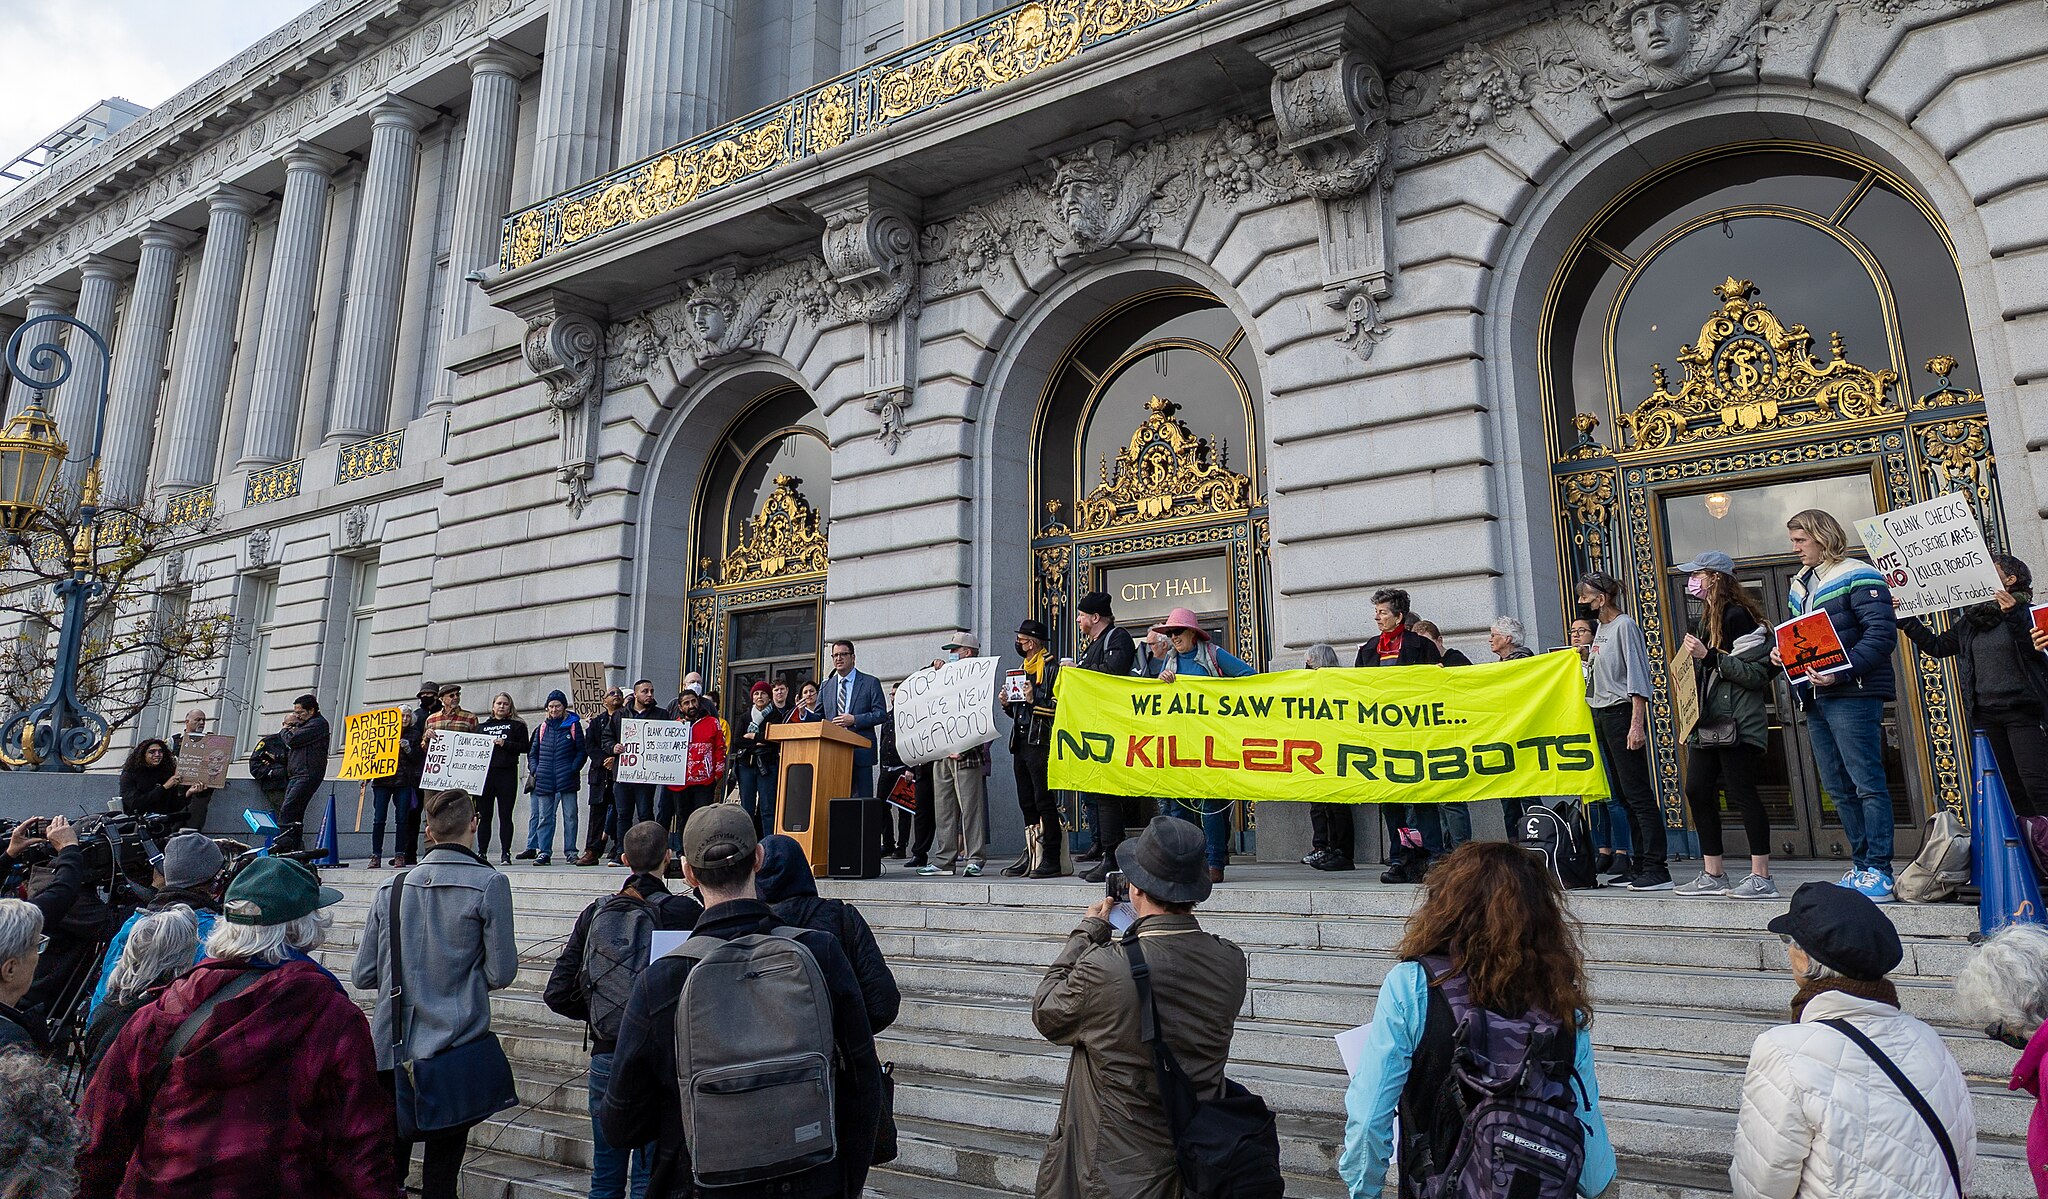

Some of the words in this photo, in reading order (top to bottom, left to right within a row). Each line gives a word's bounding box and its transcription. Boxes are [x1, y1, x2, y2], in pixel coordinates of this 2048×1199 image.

[1891, 514, 1924, 537] BLANK
[1925, 502, 1967, 527] CHECKS
[1904, 544, 1923, 559] 375
[1921, 531, 1949, 556] SECRET
[1869, 551, 1901, 571] VOTE
[1915, 562, 1947, 580] KILLER
[1945, 551, 1983, 574] ROBOTS
[1882, 568, 1909, 589] NO
[1121, 582, 1160, 602] CITY
[1165, 576, 1212, 597] HALL
[1812, 653, 1844, 669] ROBOTS!
[571, 663, 602, 680] KILL
[576, 679, 600, 690] THE
[897, 670, 937, 705] STOP
[572, 689, 606, 702] KILLER
[958, 683, 991, 712] NEW
[1131, 693, 1162, 716] WE
[1167, 692, 1209, 716] ALL
[1217, 693, 1274, 718] SAW
[1281, 696, 1349, 720] THAT
[1357, 701, 1468, 728] MOVIE...
[350, 710, 398, 732] ARMED
[351, 722, 399, 746] ROBOTS
[647, 727, 663, 737] BLANK
[664, 727, 687, 738] CHECKS
[350, 737, 397, 760] AREN'T
[458, 736, 472, 746] BLANK
[472, 737, 491, 748] CHECKS
[646, 740, 655, 750] 375
[656, 741, 671, 750] SECRET
[361, 753, 377, 761] THE
[428, 754, 448, 764] VOTE
[454, 748, 464, 757] 375
[620, 754, 638, 767] NO
[645, 753, 659, 763] KILLER
[660, 754, 682, 764] ROBOTS
[1056, 728, 1115, 763] NO
[1125, 734, 1325, 775] KILLER
[1336, 733, 1595, 784] ROBOTS
[343, 758, 396, 777] ANSWER
[424, 763, 441, 774] NO
[452, 762, 468, 771] KILLER
[468, 763, 486, 771] ROBOTS
